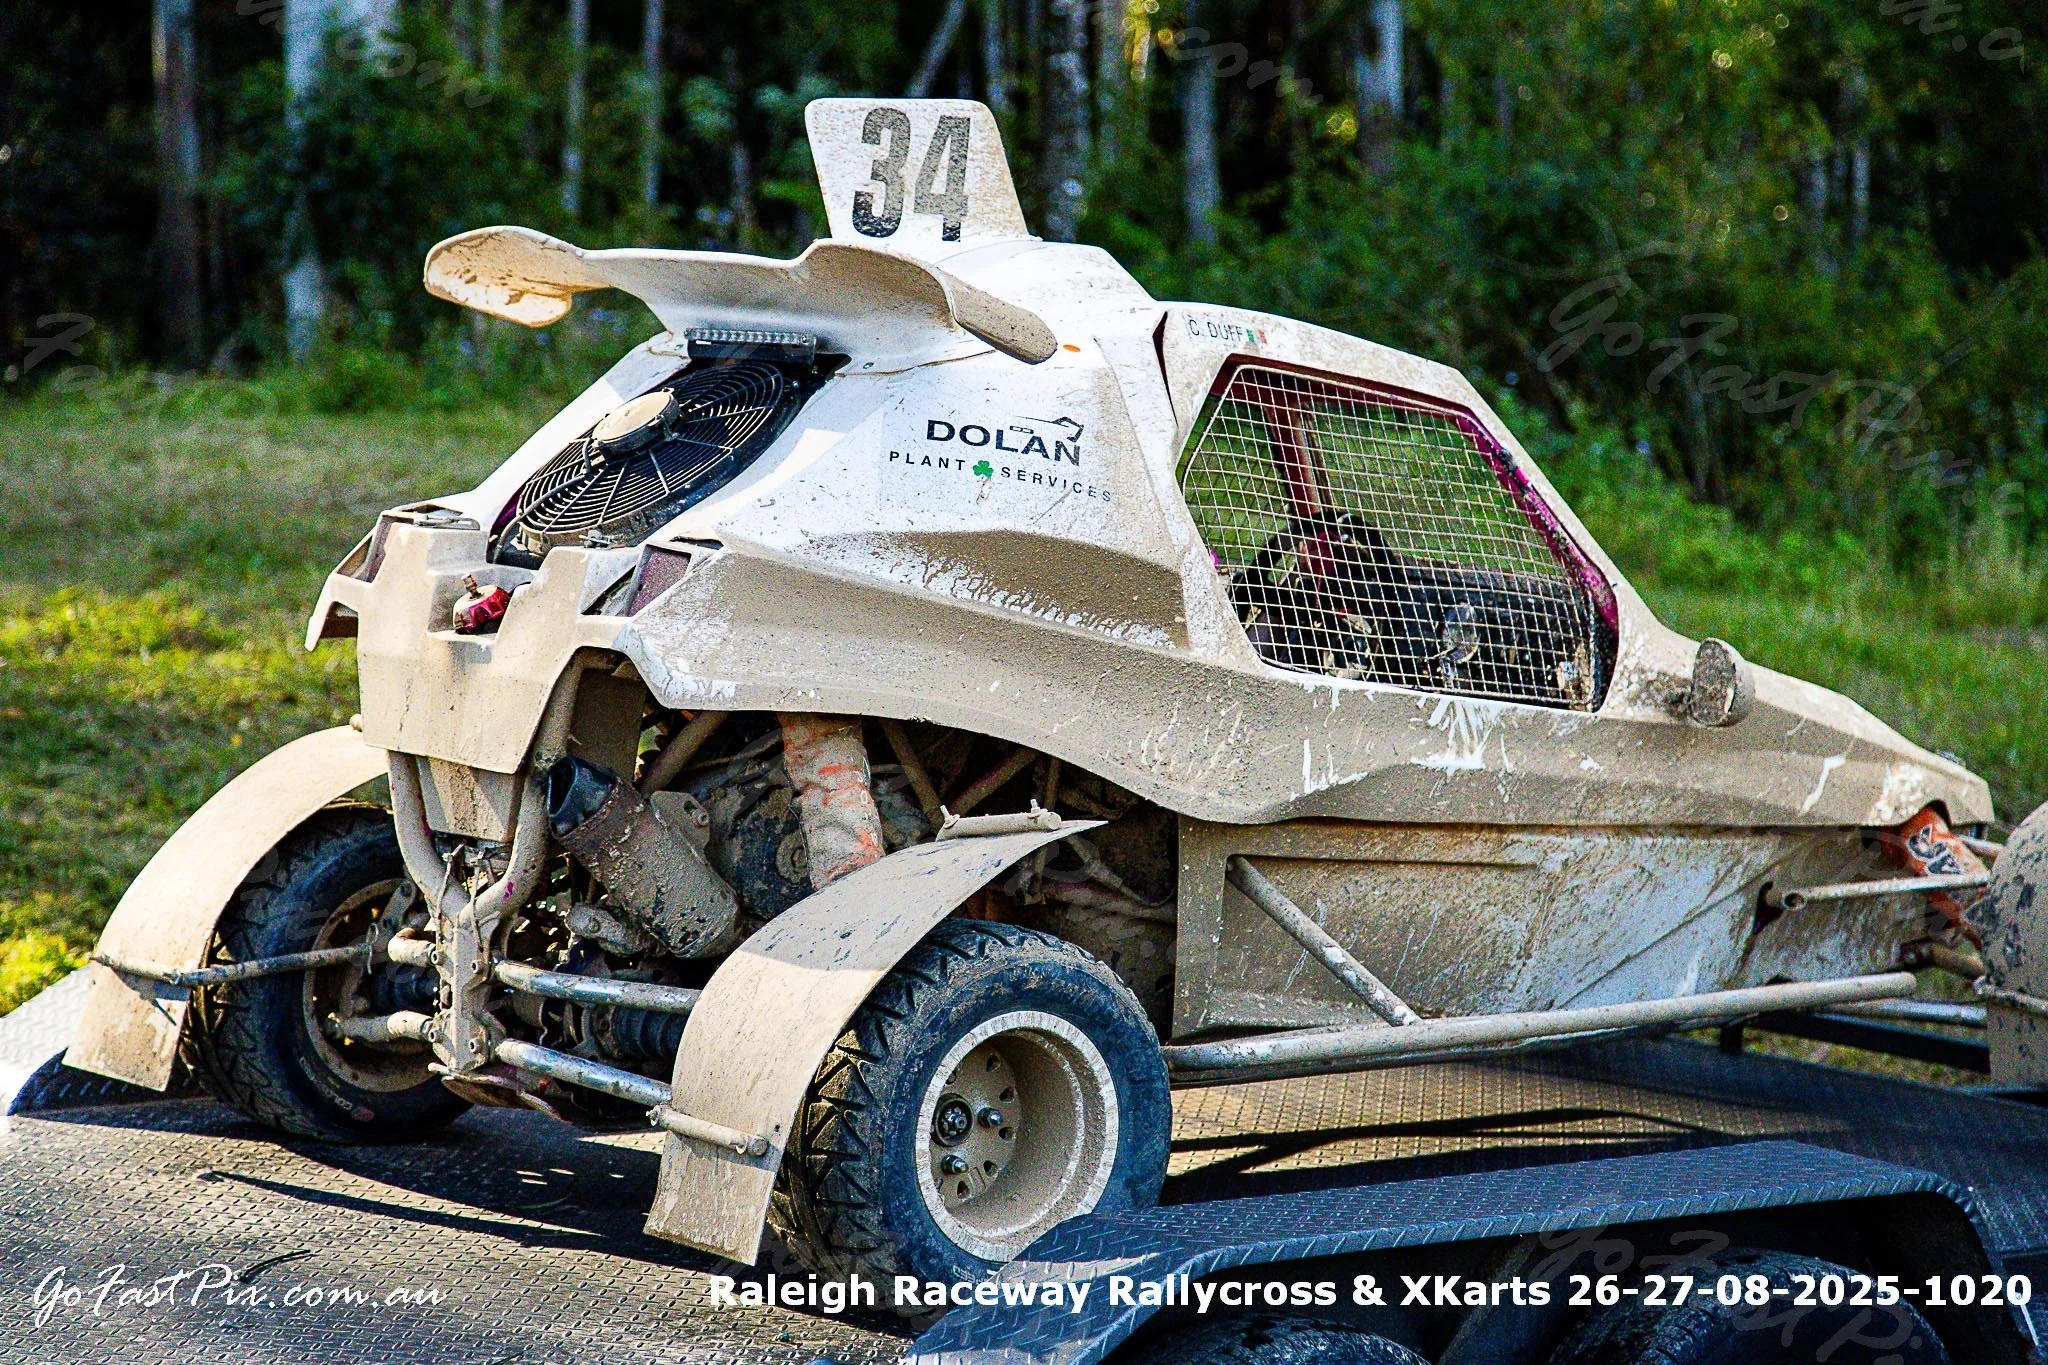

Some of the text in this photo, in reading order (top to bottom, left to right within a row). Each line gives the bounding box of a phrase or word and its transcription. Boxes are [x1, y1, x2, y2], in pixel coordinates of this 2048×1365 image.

[851, 107, 972, 243] 34
[1207, 321, 1243, 342] DUFF
[926, 419, 1081, 467] DOLAN
[889, 451, 1112, 502] PLANT SERVICES
